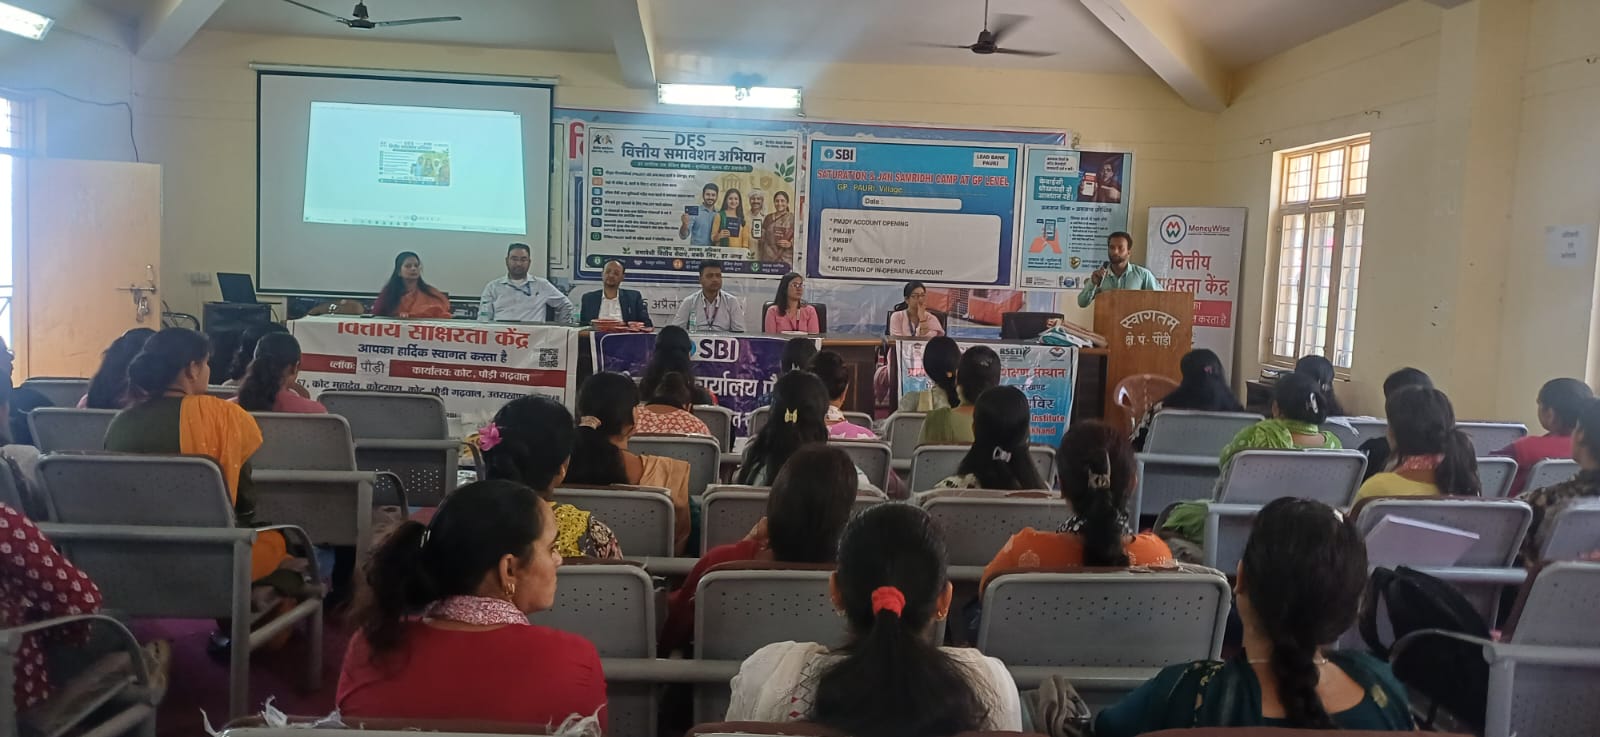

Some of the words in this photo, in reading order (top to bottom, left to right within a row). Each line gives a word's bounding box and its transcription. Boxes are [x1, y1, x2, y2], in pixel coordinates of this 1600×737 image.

[674, 133, 706, 146] DFS
[621, 141, 660, 158] वित्तीय
[664, 146, 715, 161] समावेशन
[719, 147, 766, 163] अभियान
[835, 149, 854, 161] SBI
[817, 169, 867, 181] SATURATION
[869, 171, 875, 181] &
[878, 172, 893, 182] JAN
[895, 172, 934, 184] SAMRIDHI
[935, 173, 958, 185] CAMP
[960, 174, 970, 185] AT
[972, 175, 983, 185] GP
[985, 175, 1010, 187] LEVEL
[1188, 224, 1231, 233] MoneyWise
[1170, 250, 1211, 270] वित्तीय
[831, 265, 865, 273] ACTIVATION
[915, 268, 944, 276] ACCOUNT
[1156, 277, 1201, 294] ाक्षरता
[1205, 273, 1230, 296] केंद्र
[651, 296, 677, 310] अप्रैल
[1199, 315, 1219, 325] करता
[1220, 312, 1227, 326] है
[408, 324, 488, 346] साक्षरता
[495, 327, 531, 349] केंद्र
[358, 343, 395, 356] आपका
[397, 343, 429, 358] हार्दिक
[431, 348, 468, 361] स्वागत
[470, 351, 498, 362] करता
[500, 349, 508, 363] है
[699, 338, 737, 361] SBI
[359, 359, 385, 375] पौड़ी
[478, 368, 497, 380] पौड़ी
[499, 371, 531, 382] गढ़वाल
[1031, 413, 1065, 422] Institute
